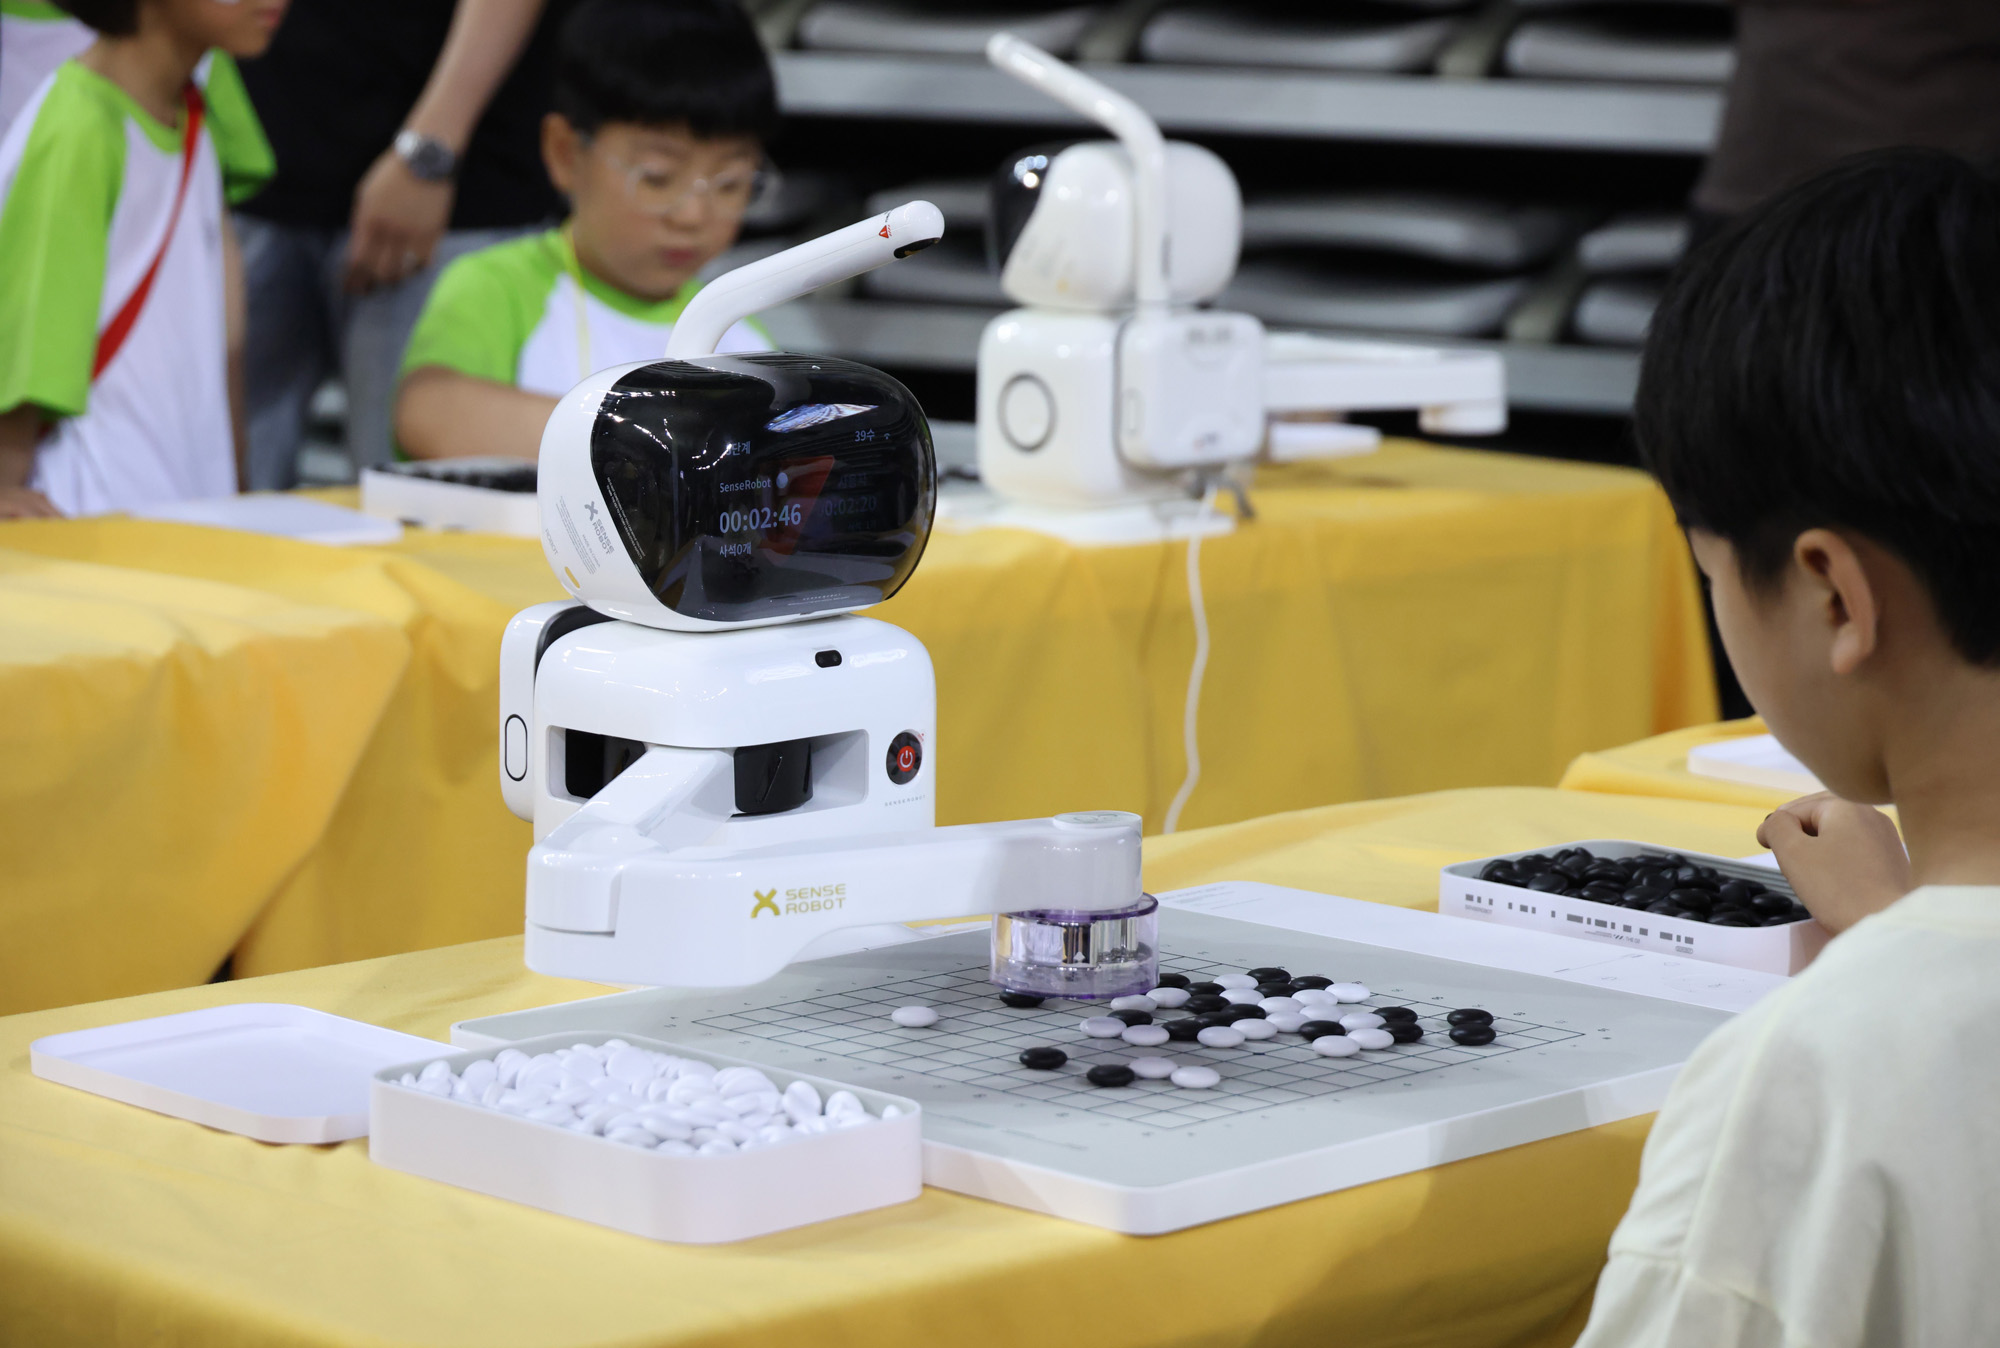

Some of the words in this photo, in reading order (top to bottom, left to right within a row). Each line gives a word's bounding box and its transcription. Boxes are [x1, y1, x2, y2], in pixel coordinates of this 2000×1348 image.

[854, 428, 876, 443] 39수
[719, 478, 771, 493] SenseRobot
[719, 503, 801, 534] 00:02:46
[592, 522, 611, 555] ROBOT
[596, 518, 615, 554] SENSE
[785, 883, 846, 901] SENSE
[785, 897, 846, 915] ROBOT
